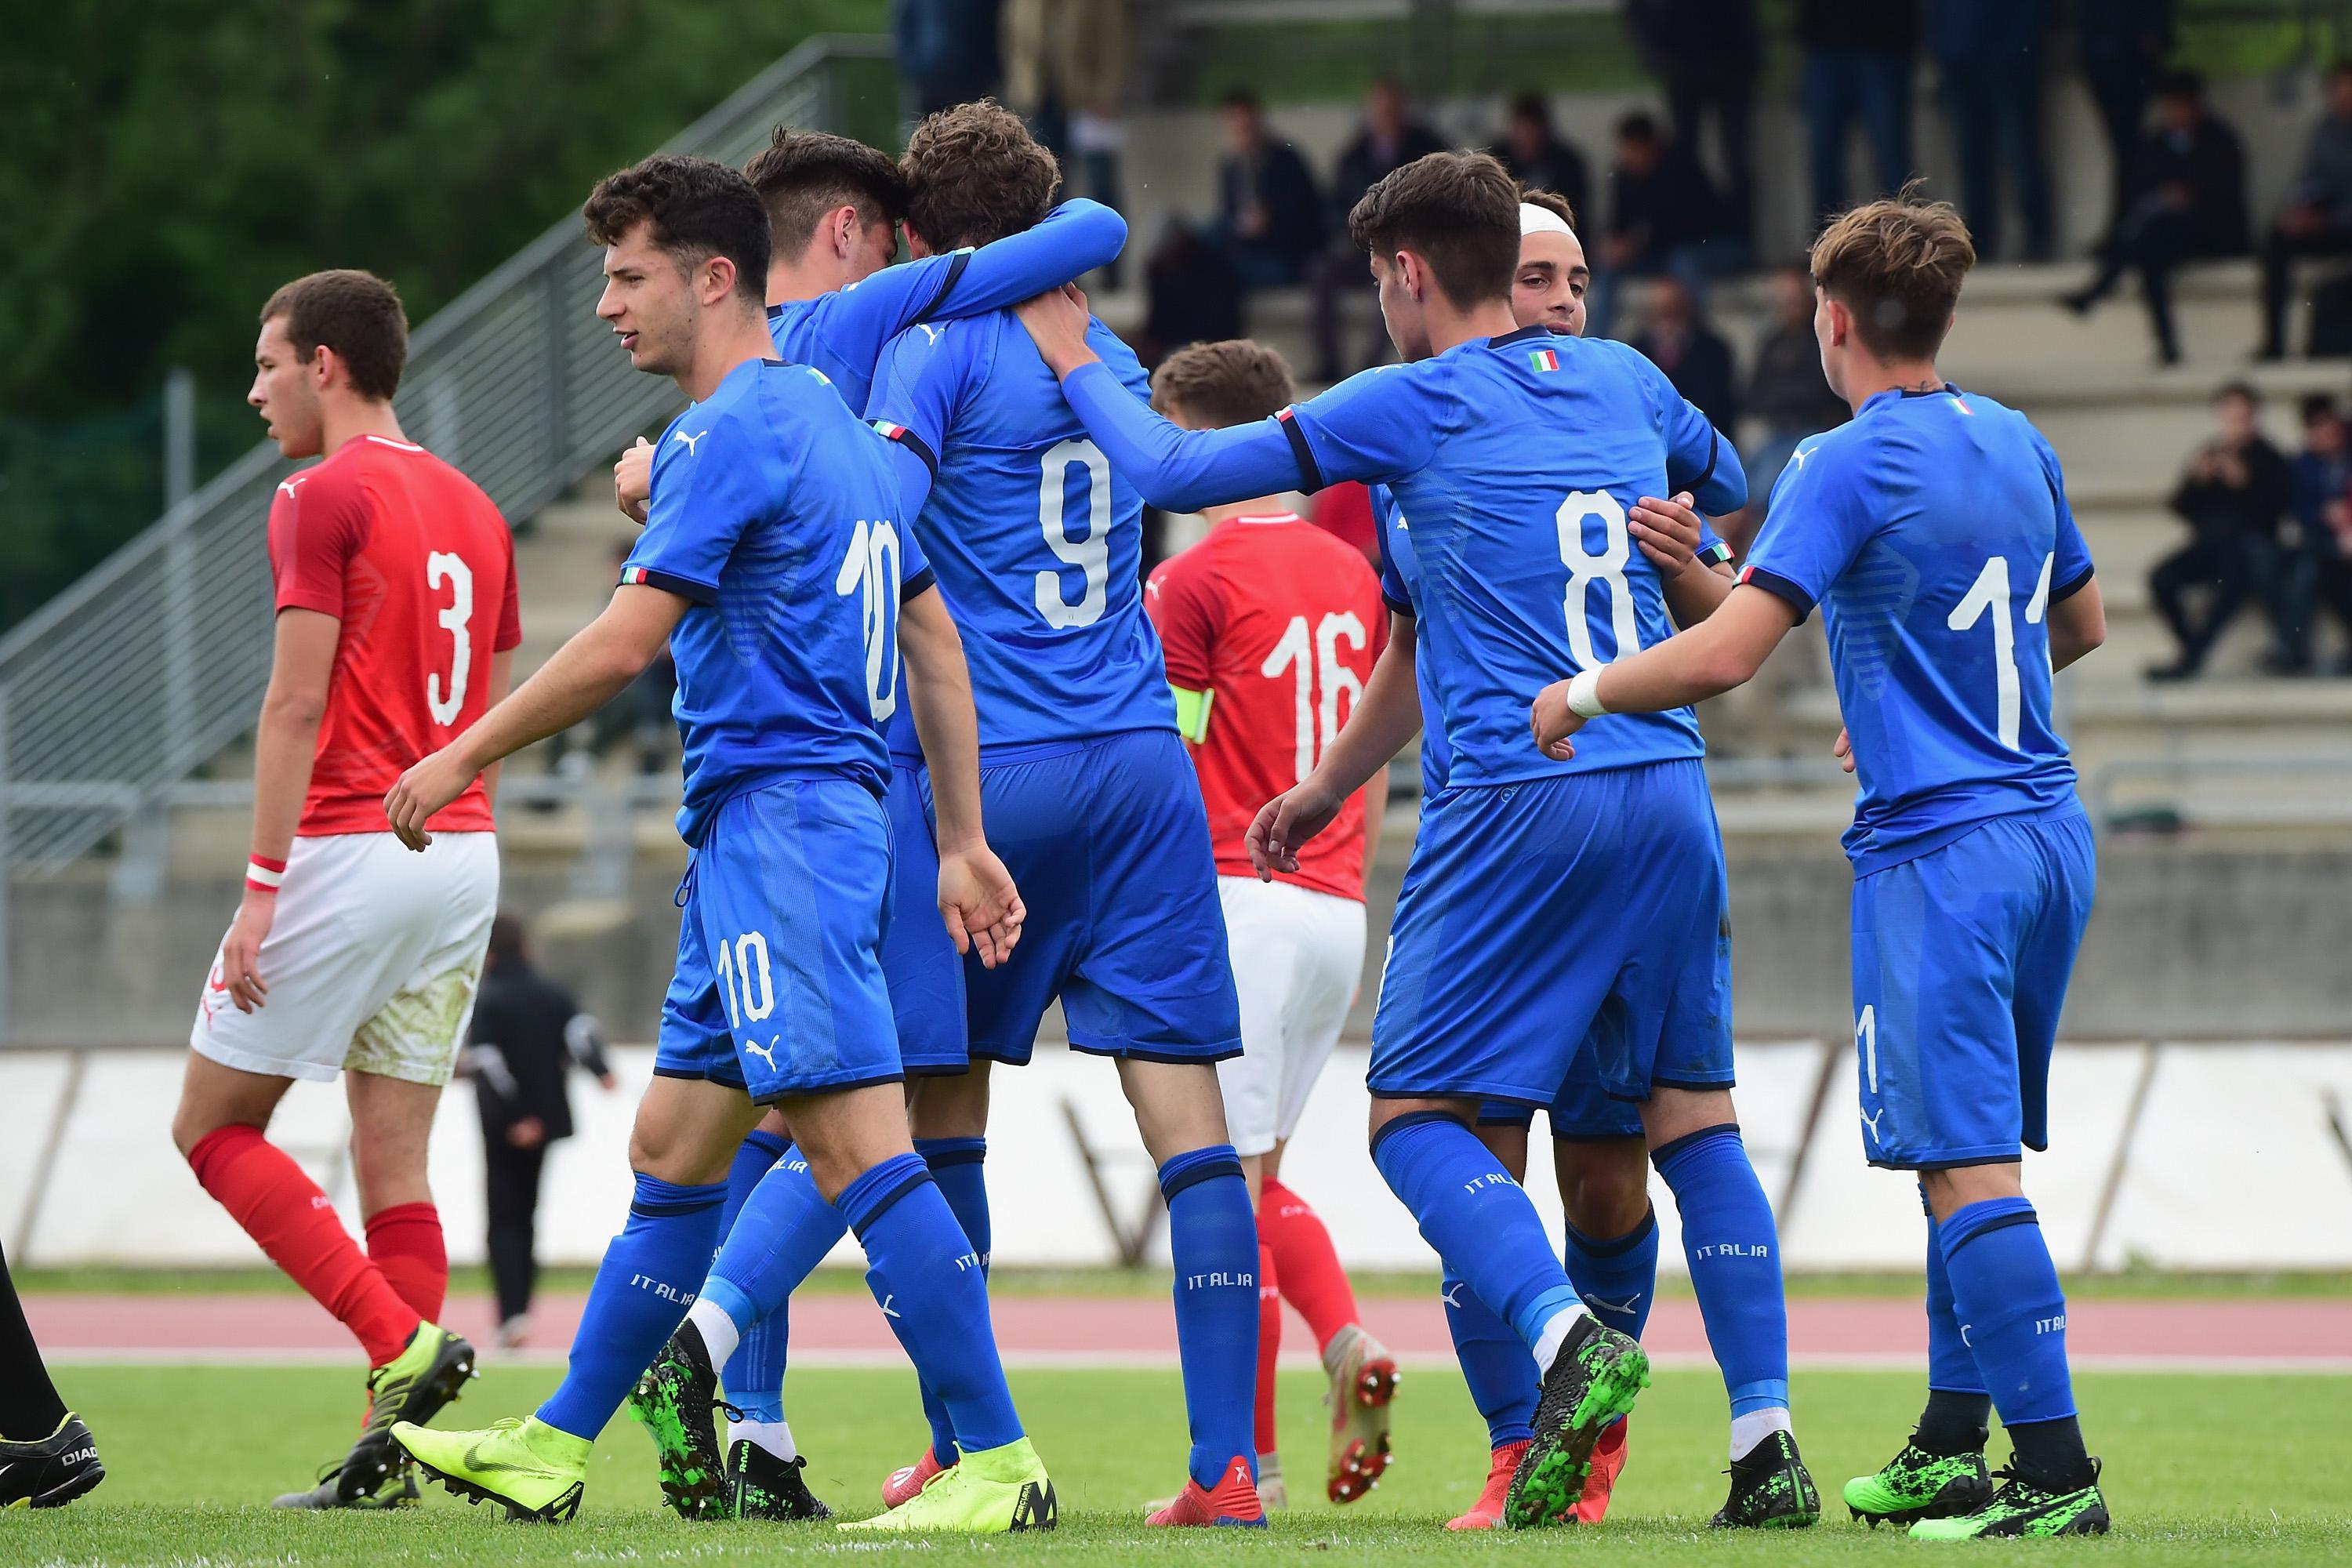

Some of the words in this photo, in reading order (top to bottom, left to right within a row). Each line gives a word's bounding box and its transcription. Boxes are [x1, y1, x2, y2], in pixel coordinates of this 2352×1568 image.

[836, 520, 902, 723] 10
[1035, 438, 1112, 630] 9
[1555, 488, 1642, 672] 8
[426, 550, 474, 727] 3
[1261, 610, 1367, 785] 16
[717, 931, 775, 1029] 10
[630, 1274, 695, 1306] ITALIA
[1188, 1272, 1253, 1290] ITALIA
[1696, 1243, 1768, 1261] ITALIA
